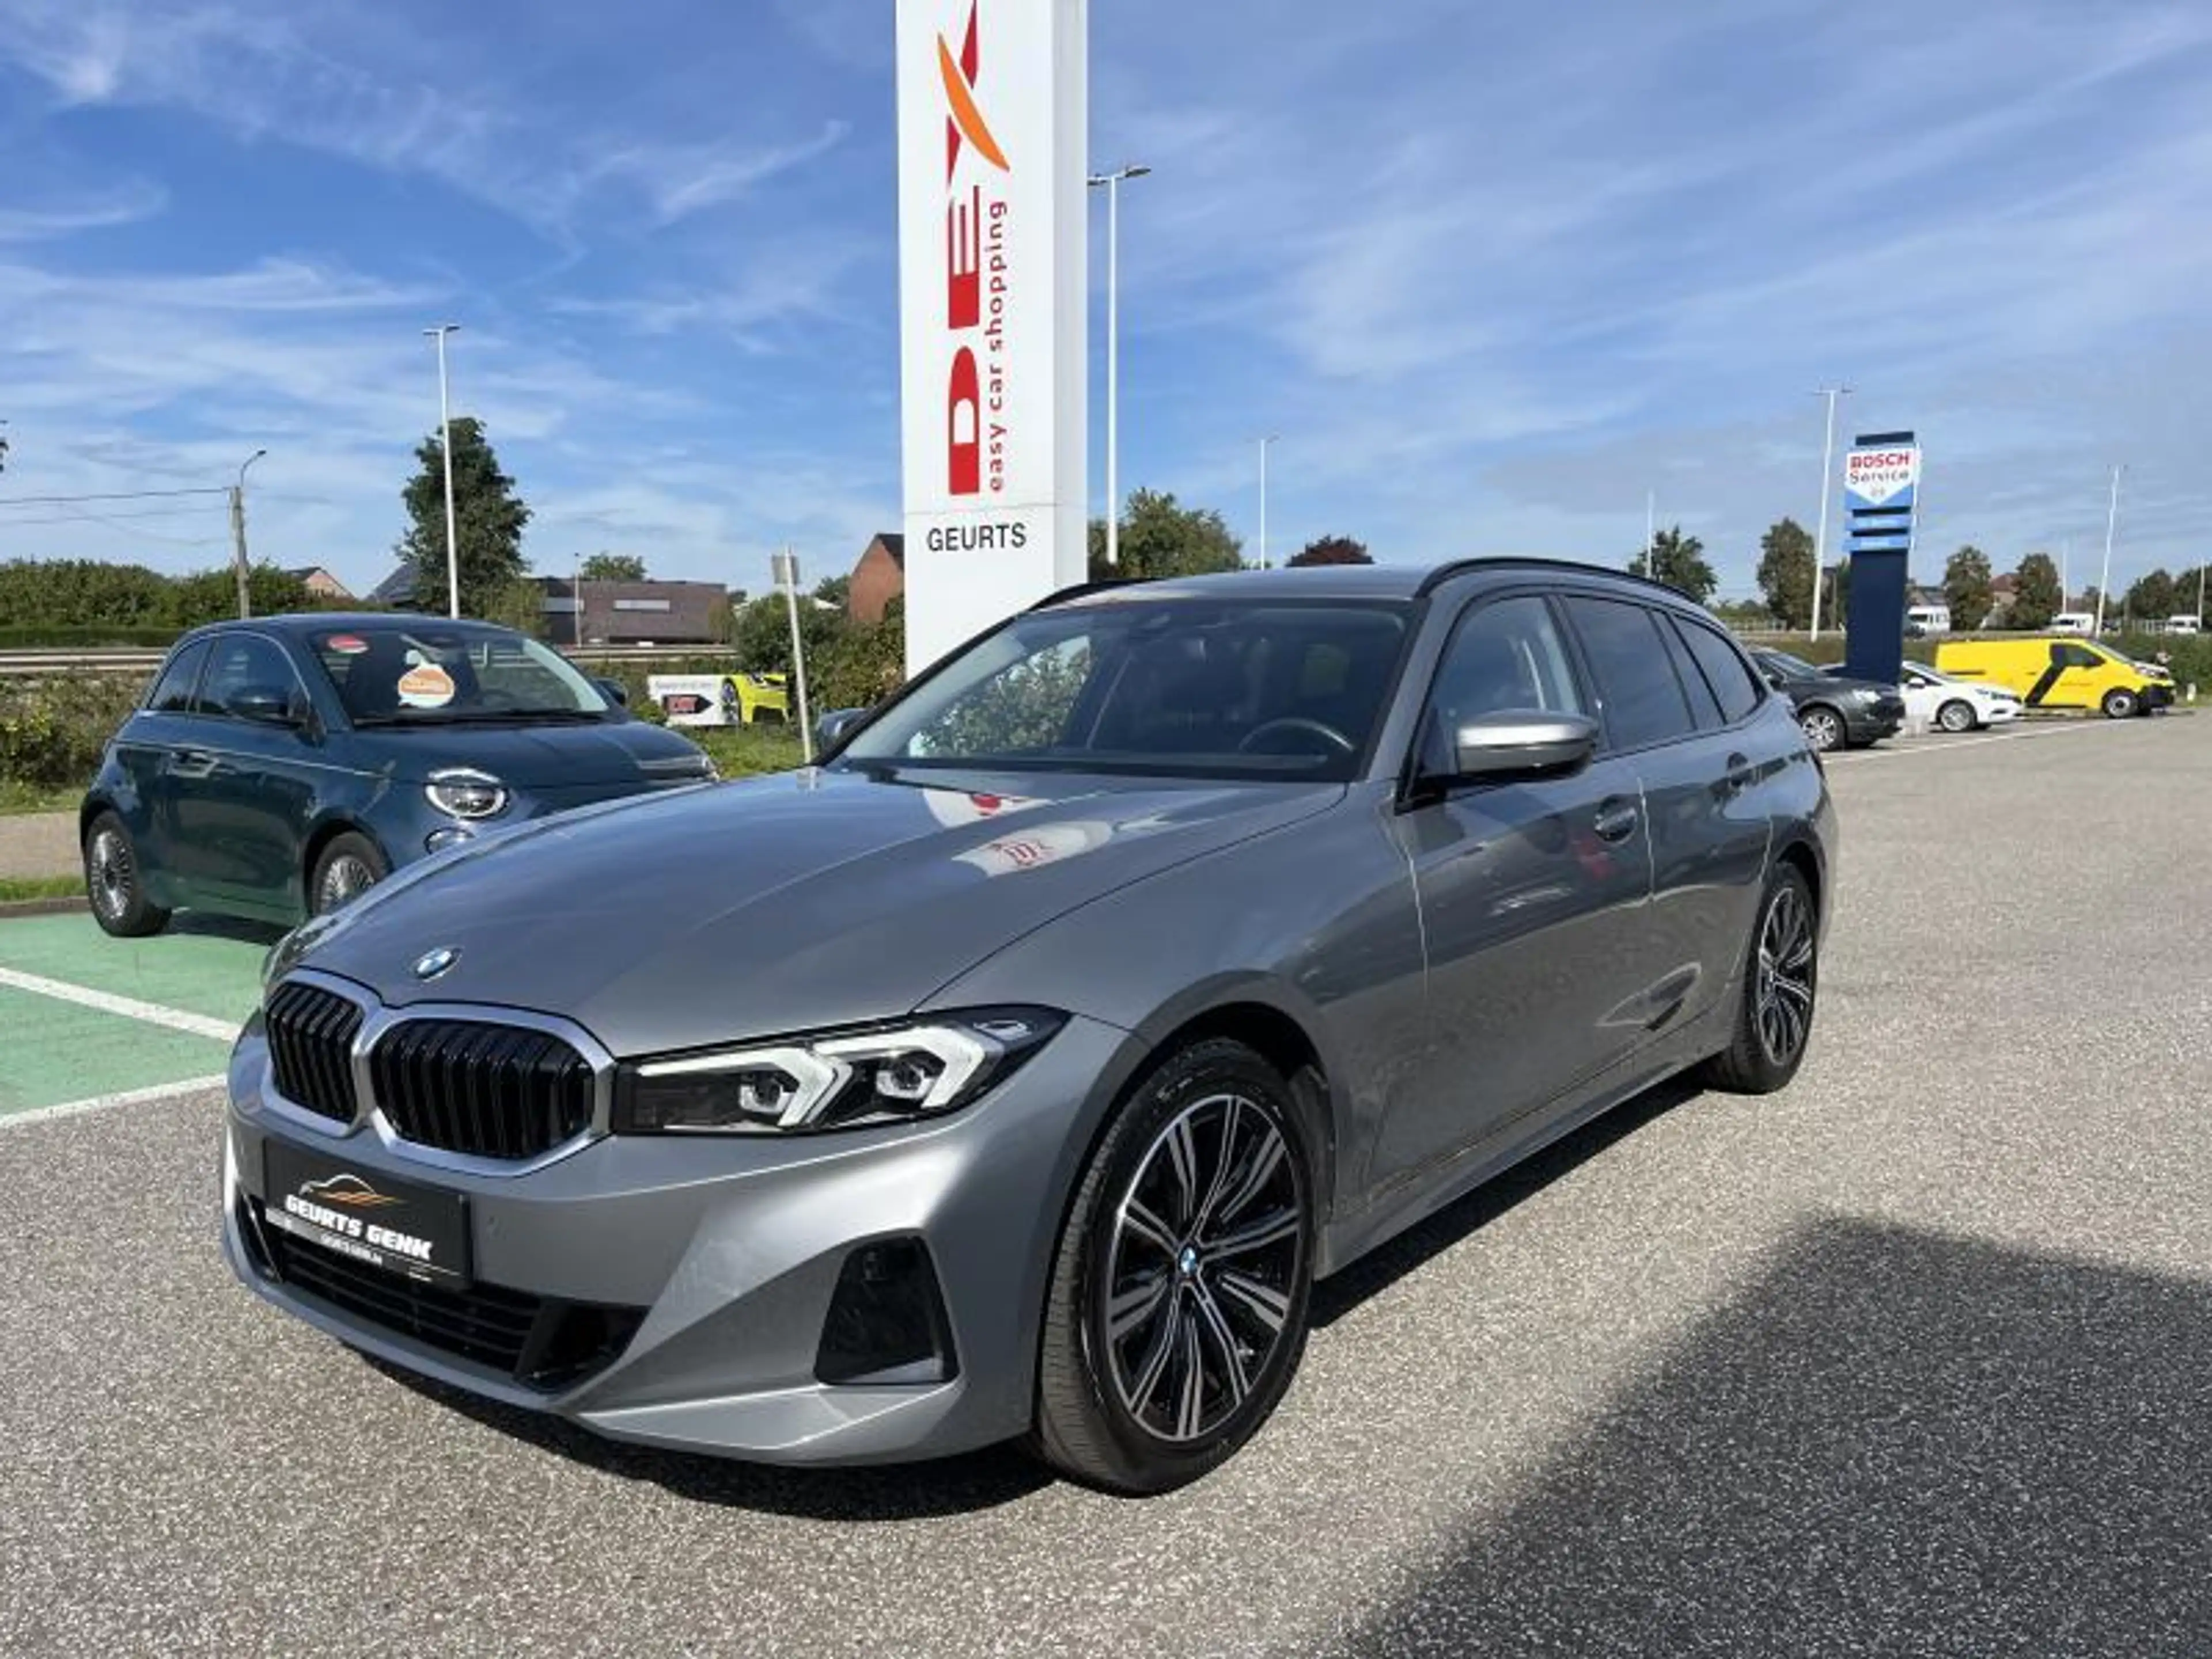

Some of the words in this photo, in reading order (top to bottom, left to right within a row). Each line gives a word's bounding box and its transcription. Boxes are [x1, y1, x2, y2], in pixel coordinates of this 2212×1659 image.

[984, 201, 1007, 352] shopping
[989, 365, 1003, 411] car
[989, 423, 1007, 491] easy
[1850, 452, 1910, 468] BOSCH
[1850, 470, 1909, 484] Service
[927, 522, 1027, 551] GEURTS
[285, 1194, 362, 1237] GEURTS
[366, 1224, 433, 1261] GENK
